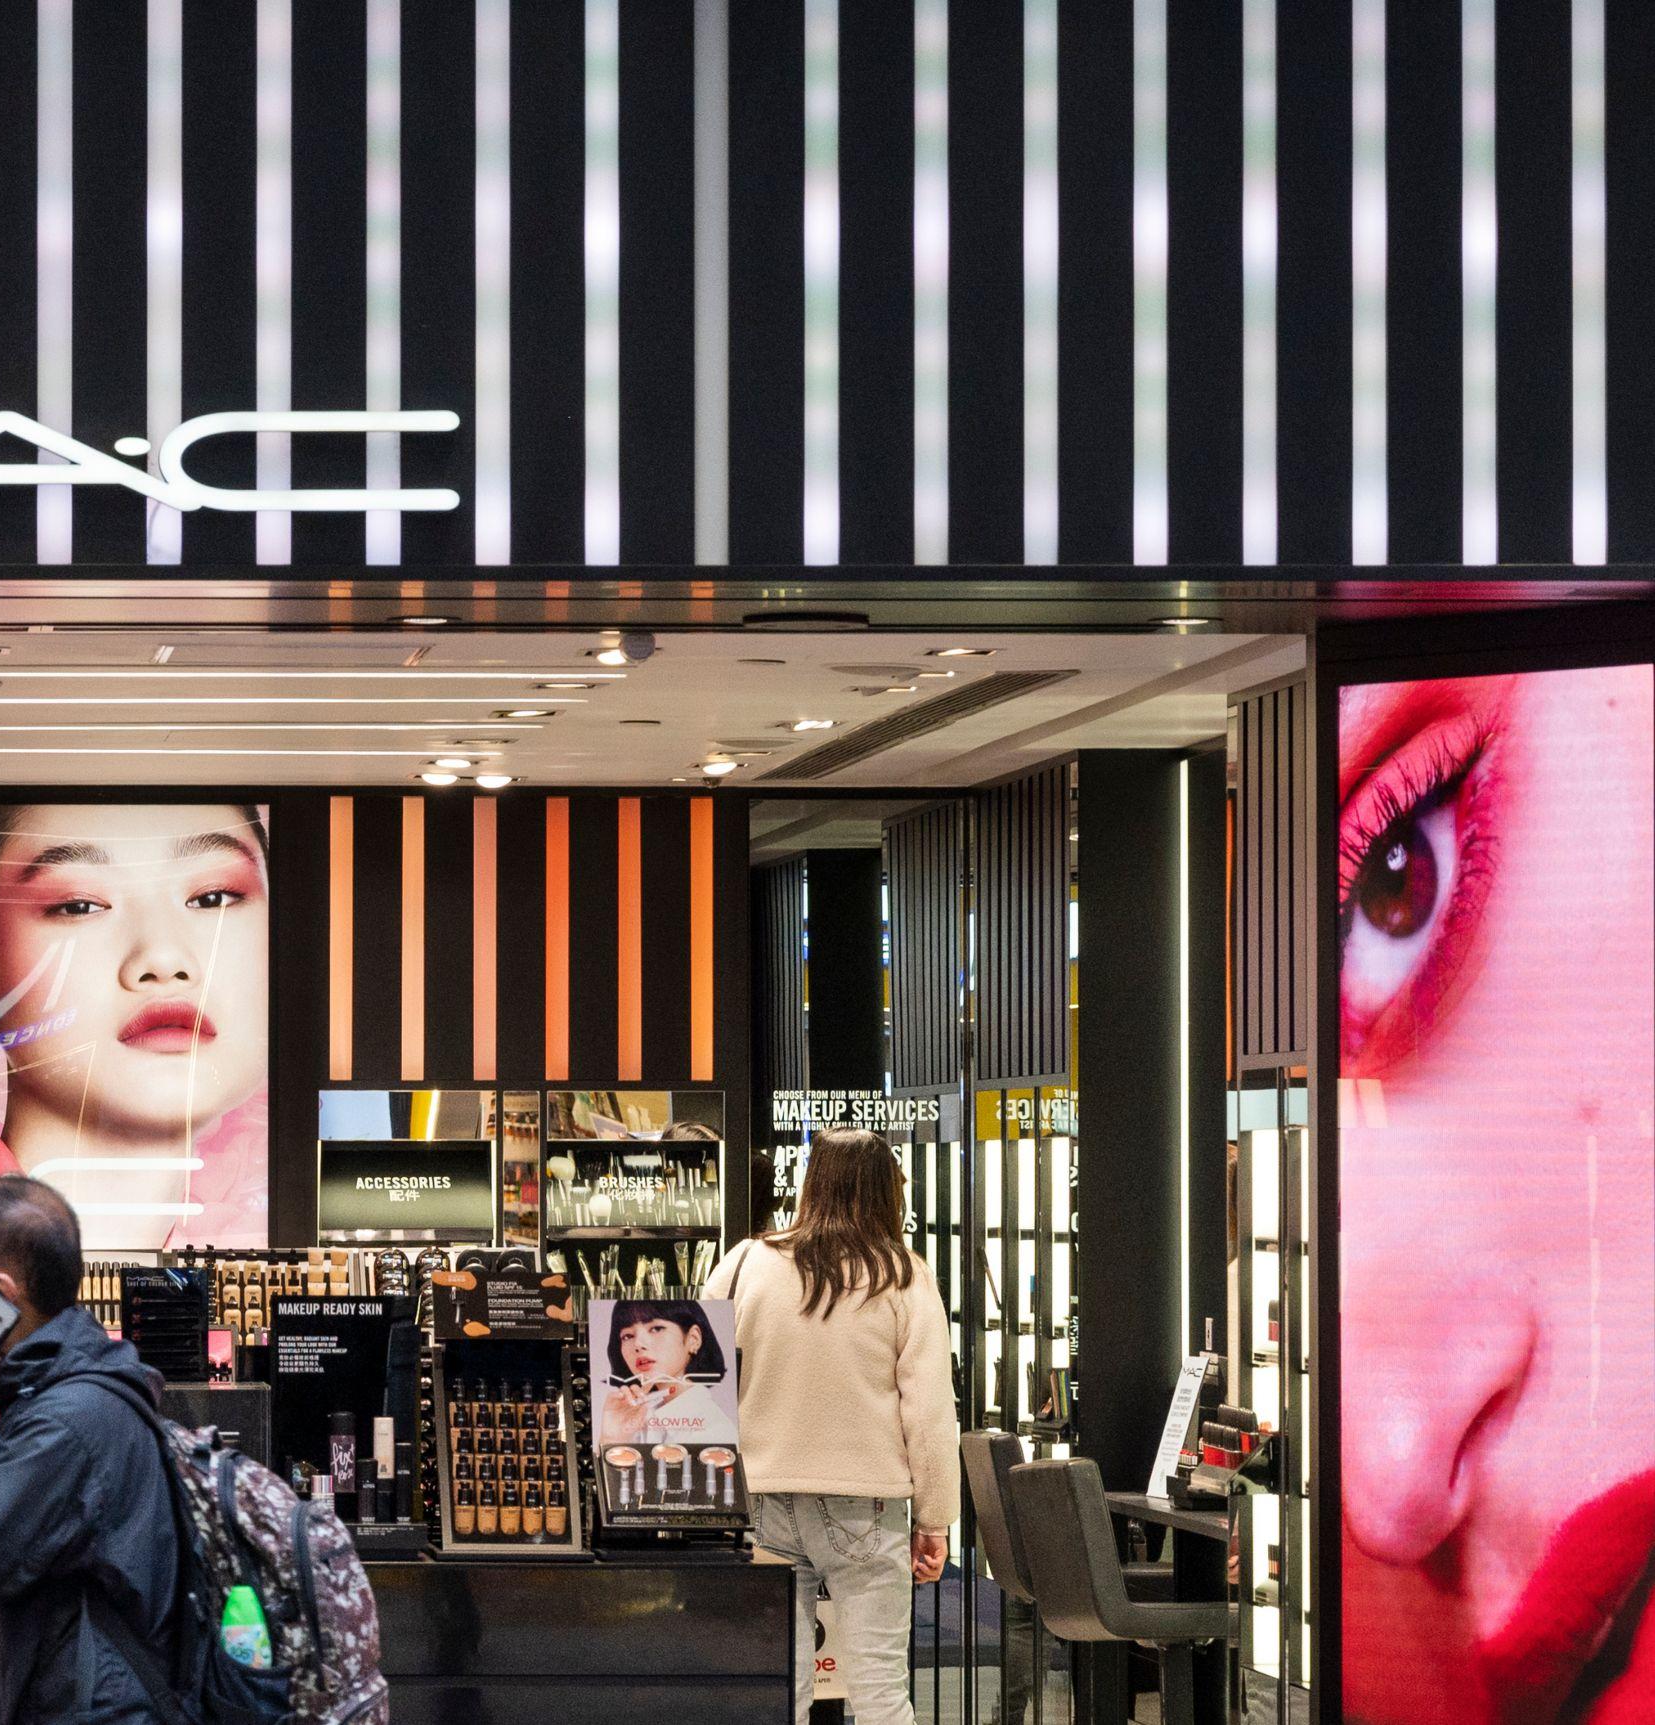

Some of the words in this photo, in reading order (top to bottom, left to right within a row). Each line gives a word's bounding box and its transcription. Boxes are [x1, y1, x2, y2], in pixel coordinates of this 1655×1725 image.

[773, 1090, 804, 1100] CHOOSE
[806, 1090, 828, 1100] FROM
[830, 1090, 846, 1100] OUR
[849, 1090, 870, 1099] MENU
[872, 1090, 883, 1099] OF
[773, 1100, 846, 1121] MAKEUP
[852, 1100, 939, 1121] SERVICES
[774, 1121, 793, 1131] WITH
[795, 1121, 800, 1131] A
[888, 1121, 915, 1131] ARTIST
[356, 1176, 451, 1189] ACCESSORIES
[599, 1176, 664, 1189] BRUSHES
[278, 1303, 320, 1315] MAKEUP
[323, 1303, 356, 1315] READY
[358, 1303, 383, 1315] SKIN
[647, 1418, 680, 1427] GLOW
[682, 1418, 705, 1427] PLAY
